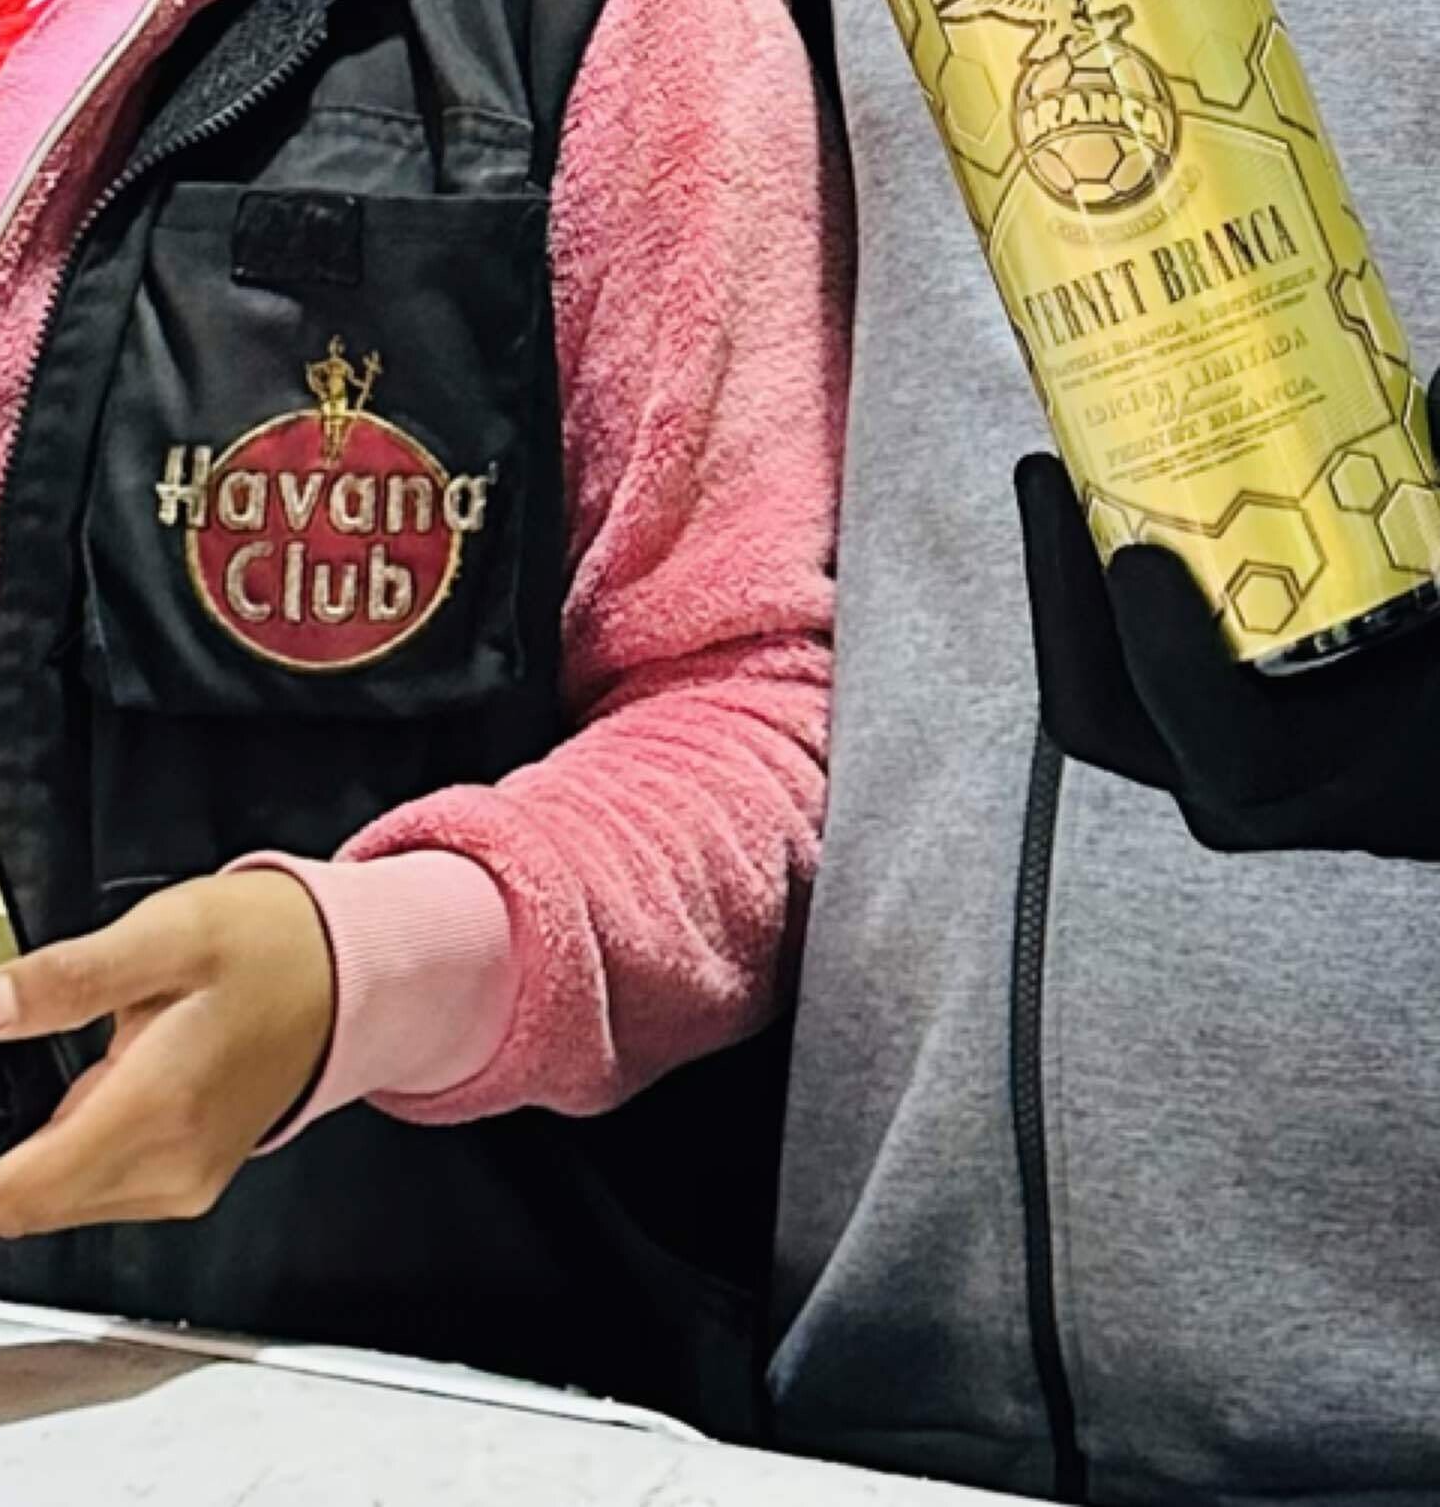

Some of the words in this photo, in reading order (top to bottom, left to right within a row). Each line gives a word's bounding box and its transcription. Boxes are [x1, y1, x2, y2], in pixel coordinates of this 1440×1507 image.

[1021, 90, 1166, 142] BRANCA
[1022, 256, 1149, 352] FERNET
[1150, 203, 1300, 306] BRANCA
[156, 445, 490, 533] Havana
[226, 540, 413, 624] Club
